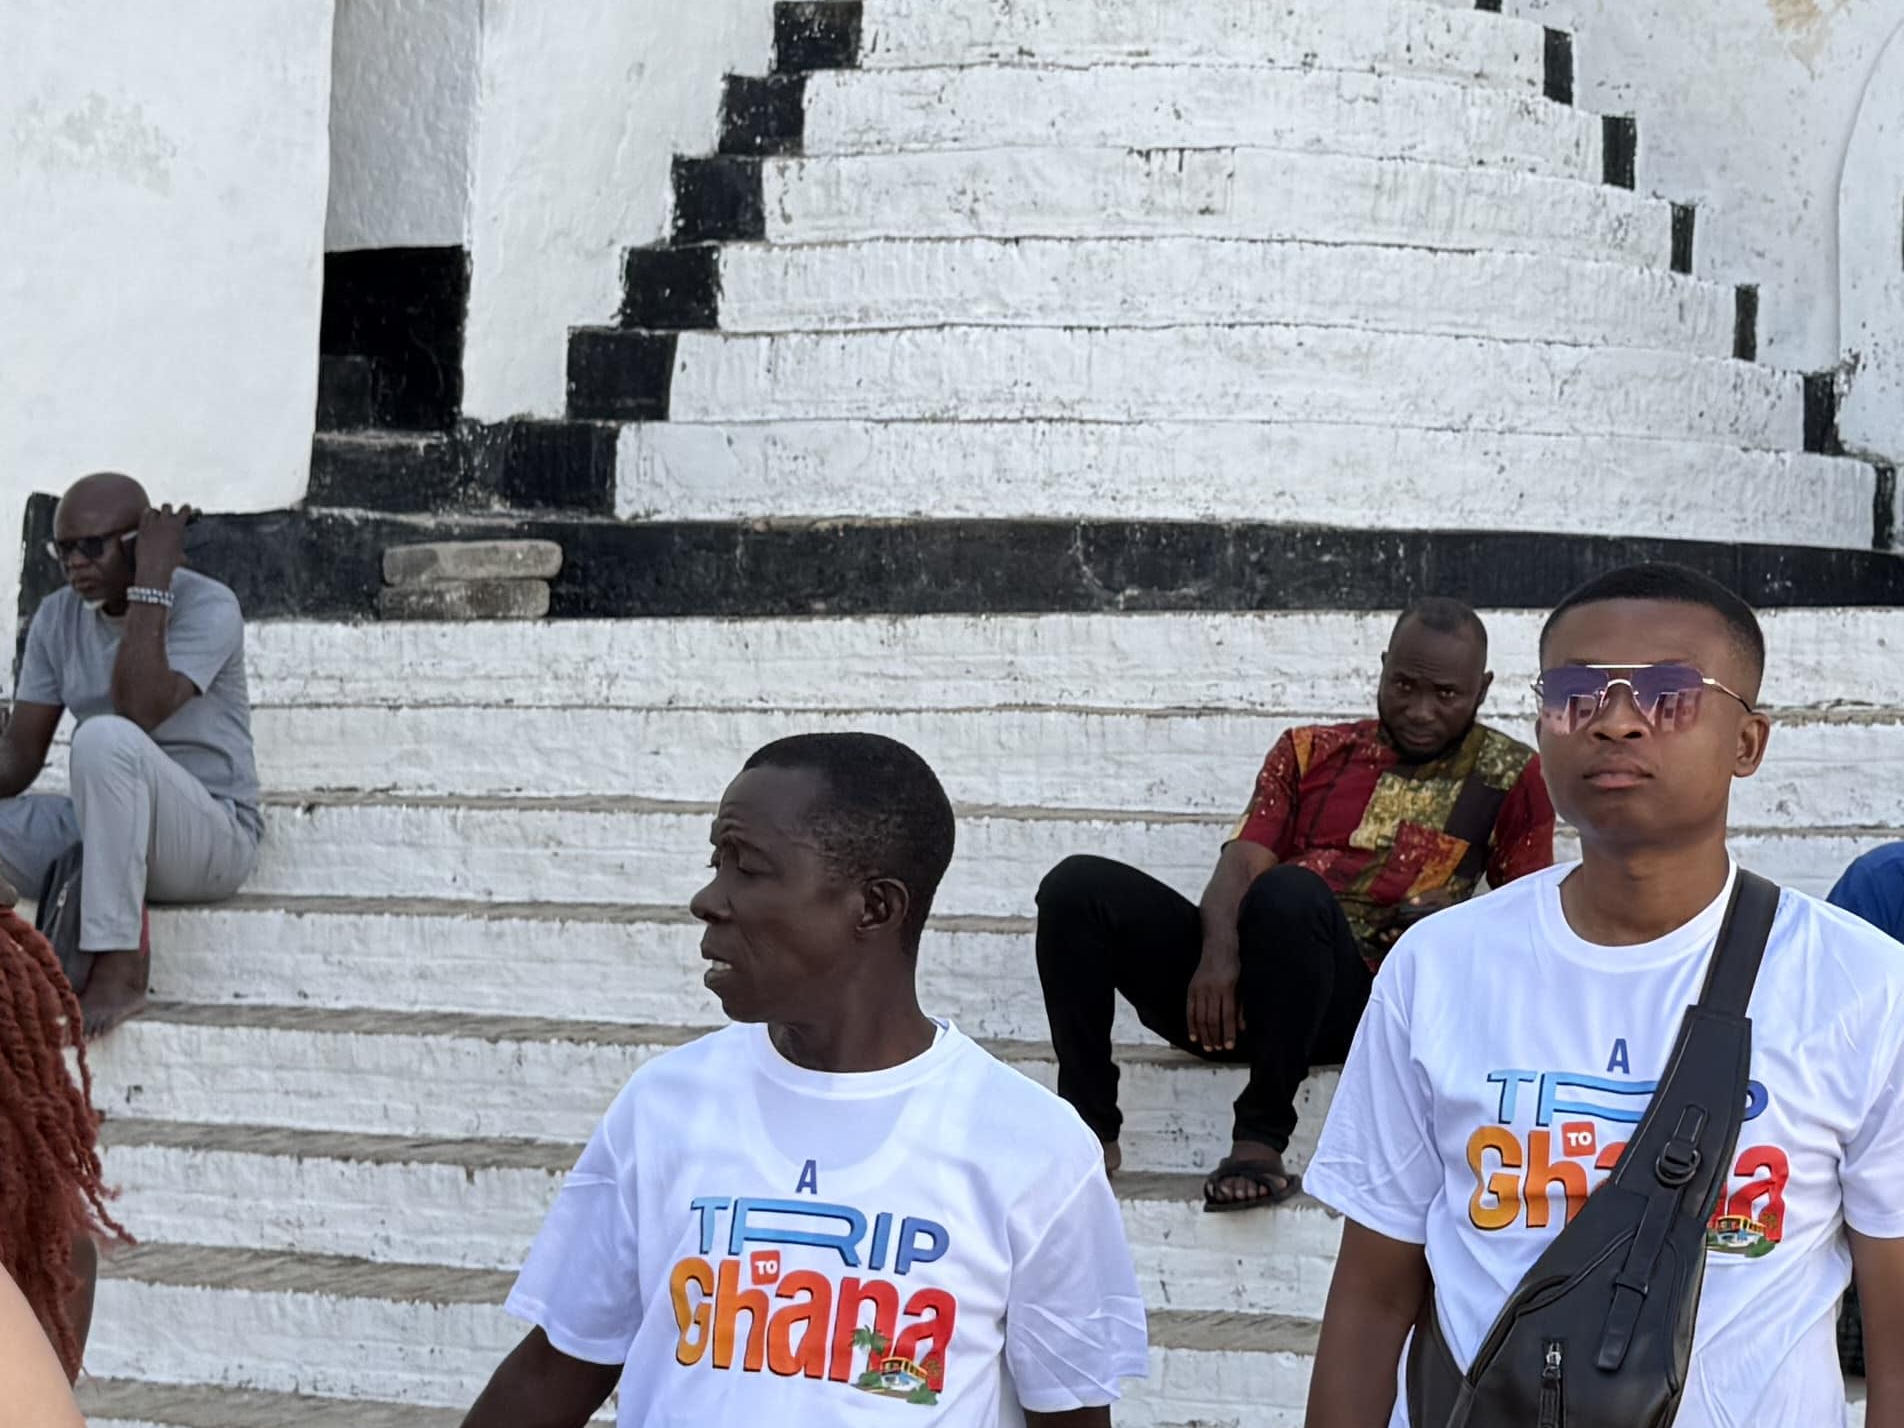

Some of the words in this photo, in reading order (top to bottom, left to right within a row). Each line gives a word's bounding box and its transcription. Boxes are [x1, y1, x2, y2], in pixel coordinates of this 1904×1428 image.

[1607, 1038, 1630, 1074] A
[1567, 1132, 1592, 1146] TO
[796, 1160, 818, 1194] A
[1466, 1126, 1788, 1244] Gha
[690, 1196, 950, 1275] TRIP
[755, 1260, 778, 1274] TO
[669, 1257, 956, 1393] Ghana
